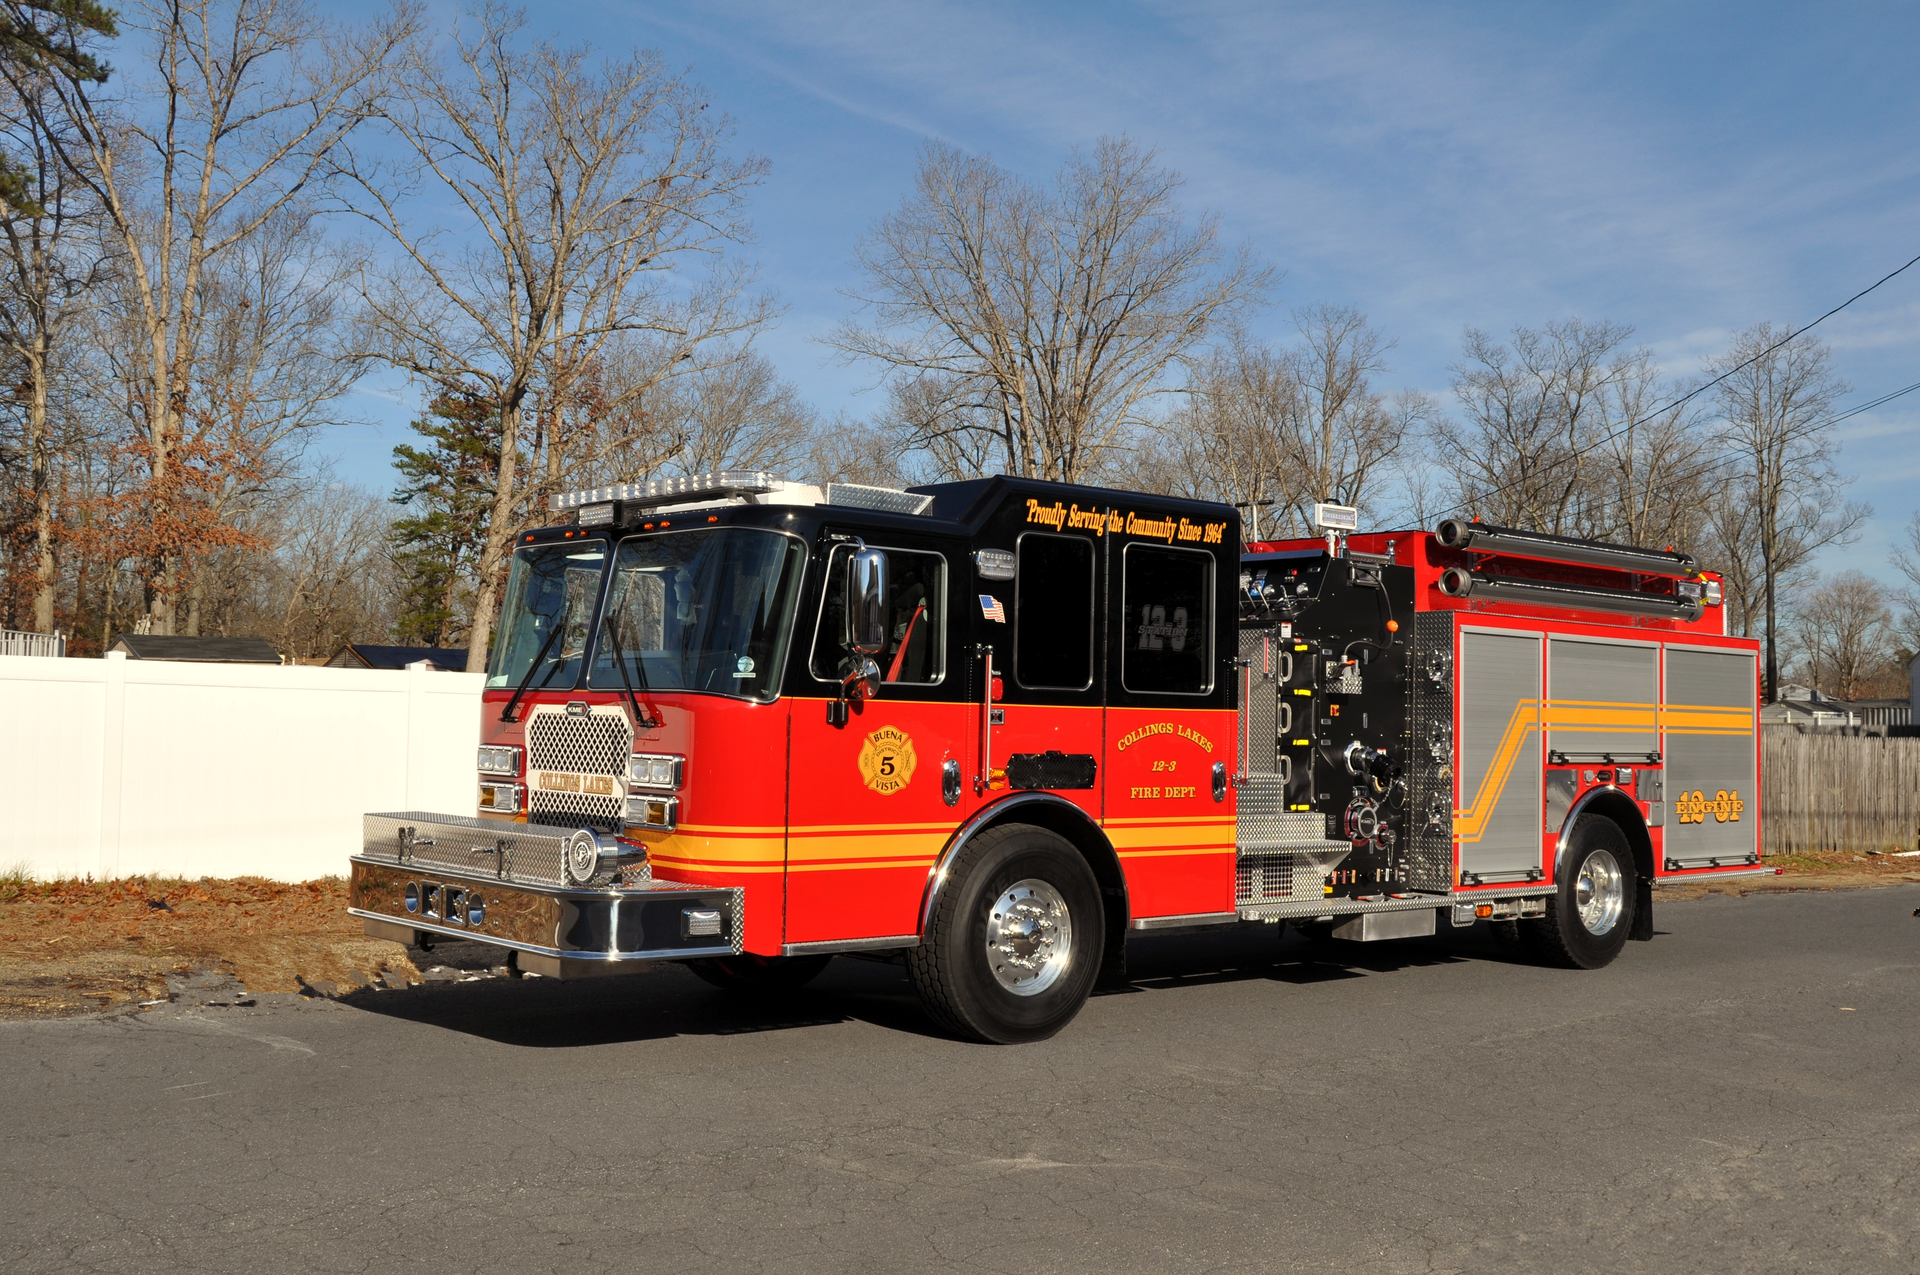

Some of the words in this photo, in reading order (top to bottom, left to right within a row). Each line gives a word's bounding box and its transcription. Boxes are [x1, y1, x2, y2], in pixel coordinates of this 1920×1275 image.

[1068, 504, 1108, 537] Serving
[1108, 510, 1124, 533] the
[1126, 512, 1177, 544] Community
[1177, 518, 1202, 542] Since
[1137, 625, 1189, 637] STATION
[873, 730, 903, 743] BUENA
[1117, 722, 1174, 751] COLLINGS
[1177, 724, 1214, 753] LAKES
[875, 747, 900, 757] DISTRICT
[880, 756, 895, 776] 5
[1151, 760, 1177, 772] 12-3
[538, 772, 581, 793] COLLINGS
[582, 775, 613, 796] LAKES
[875, 780, 900, 791] VISTA
[1130, 787, 1161, 799] FIRE
[1674, 799, 1744, 814] ENGINE
